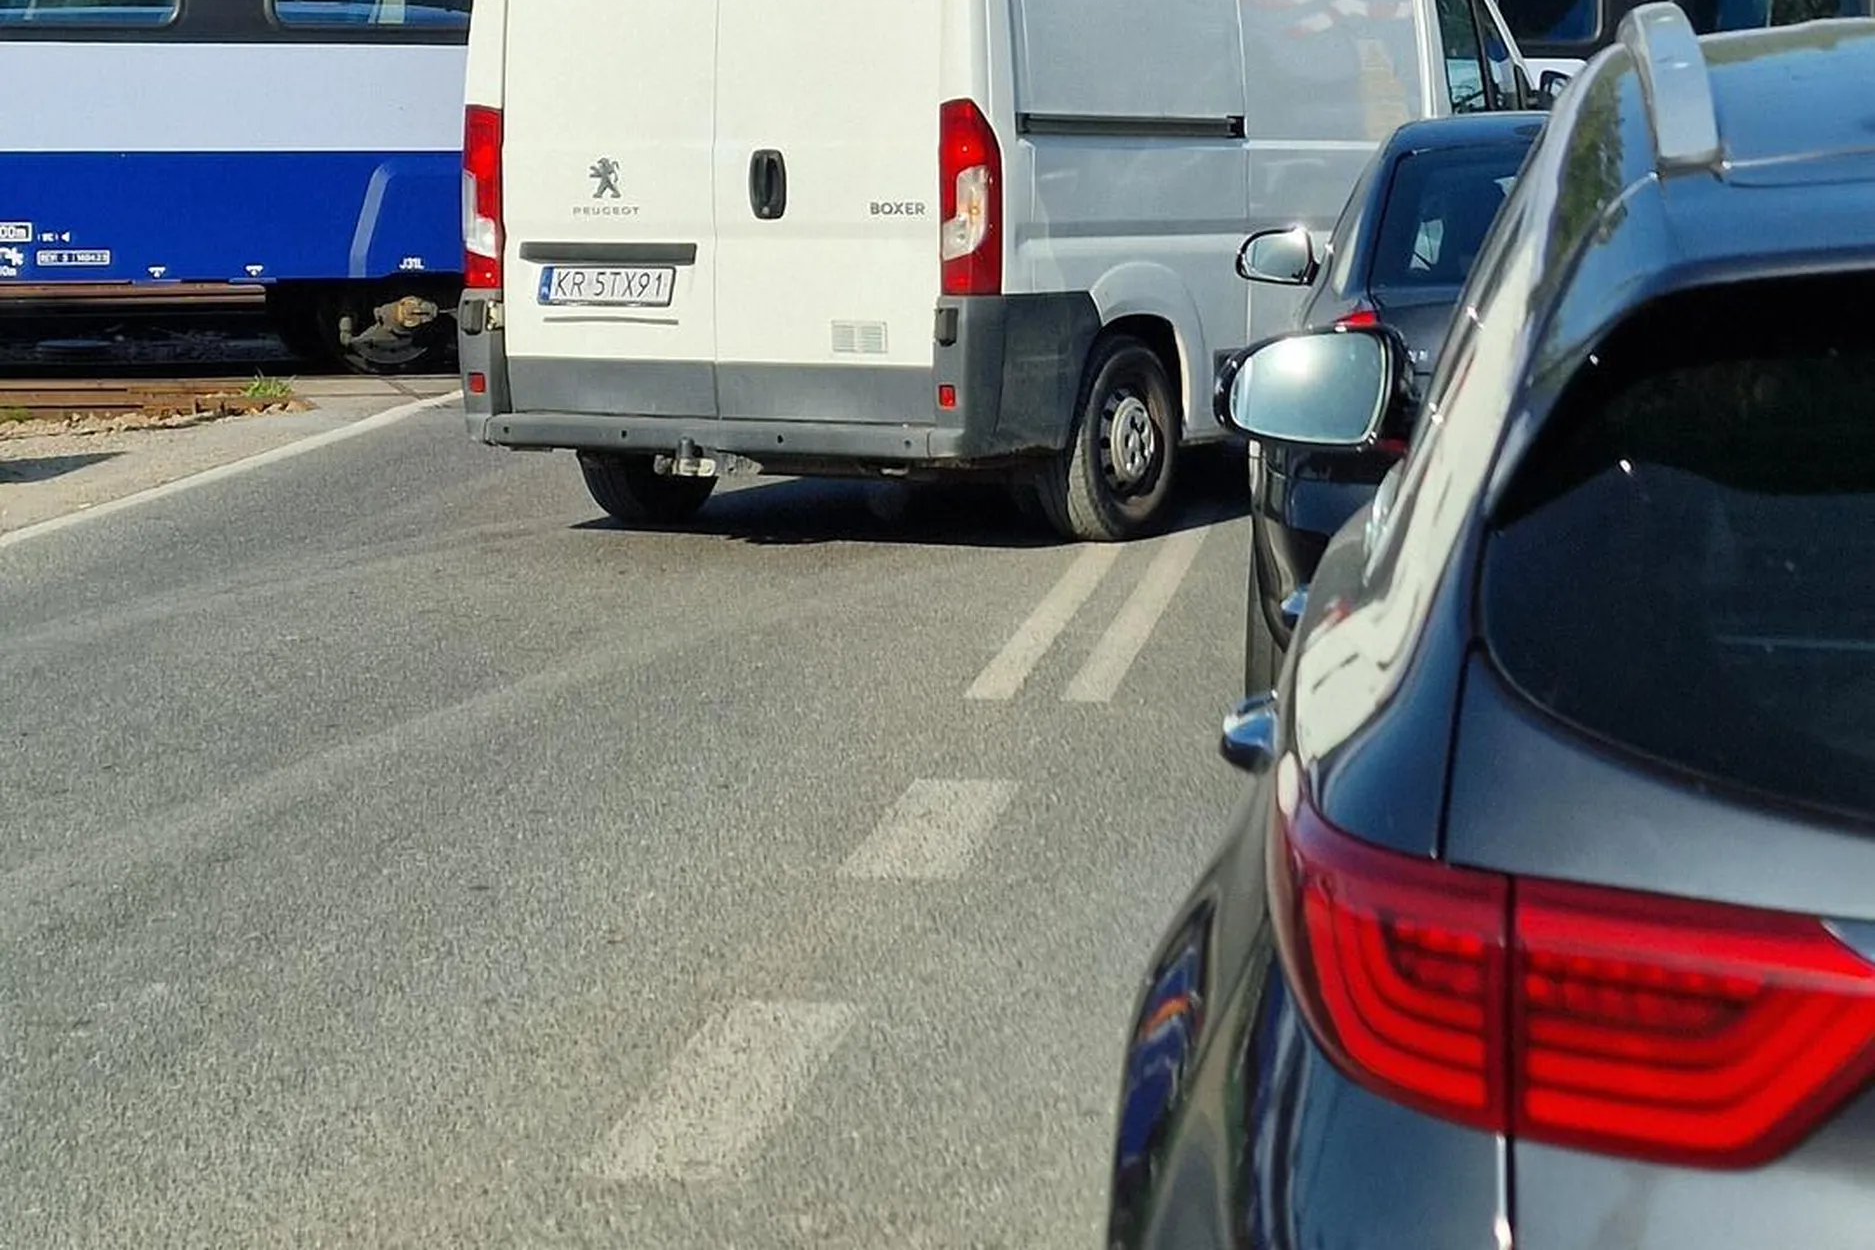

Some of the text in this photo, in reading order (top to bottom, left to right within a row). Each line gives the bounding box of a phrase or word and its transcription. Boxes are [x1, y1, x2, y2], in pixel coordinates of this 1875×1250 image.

[572, 206, 640, 216] PEUGEOT
[869, 202, 926, 215] BOXER
[555, 271, 662, 298] KR 5TX91
